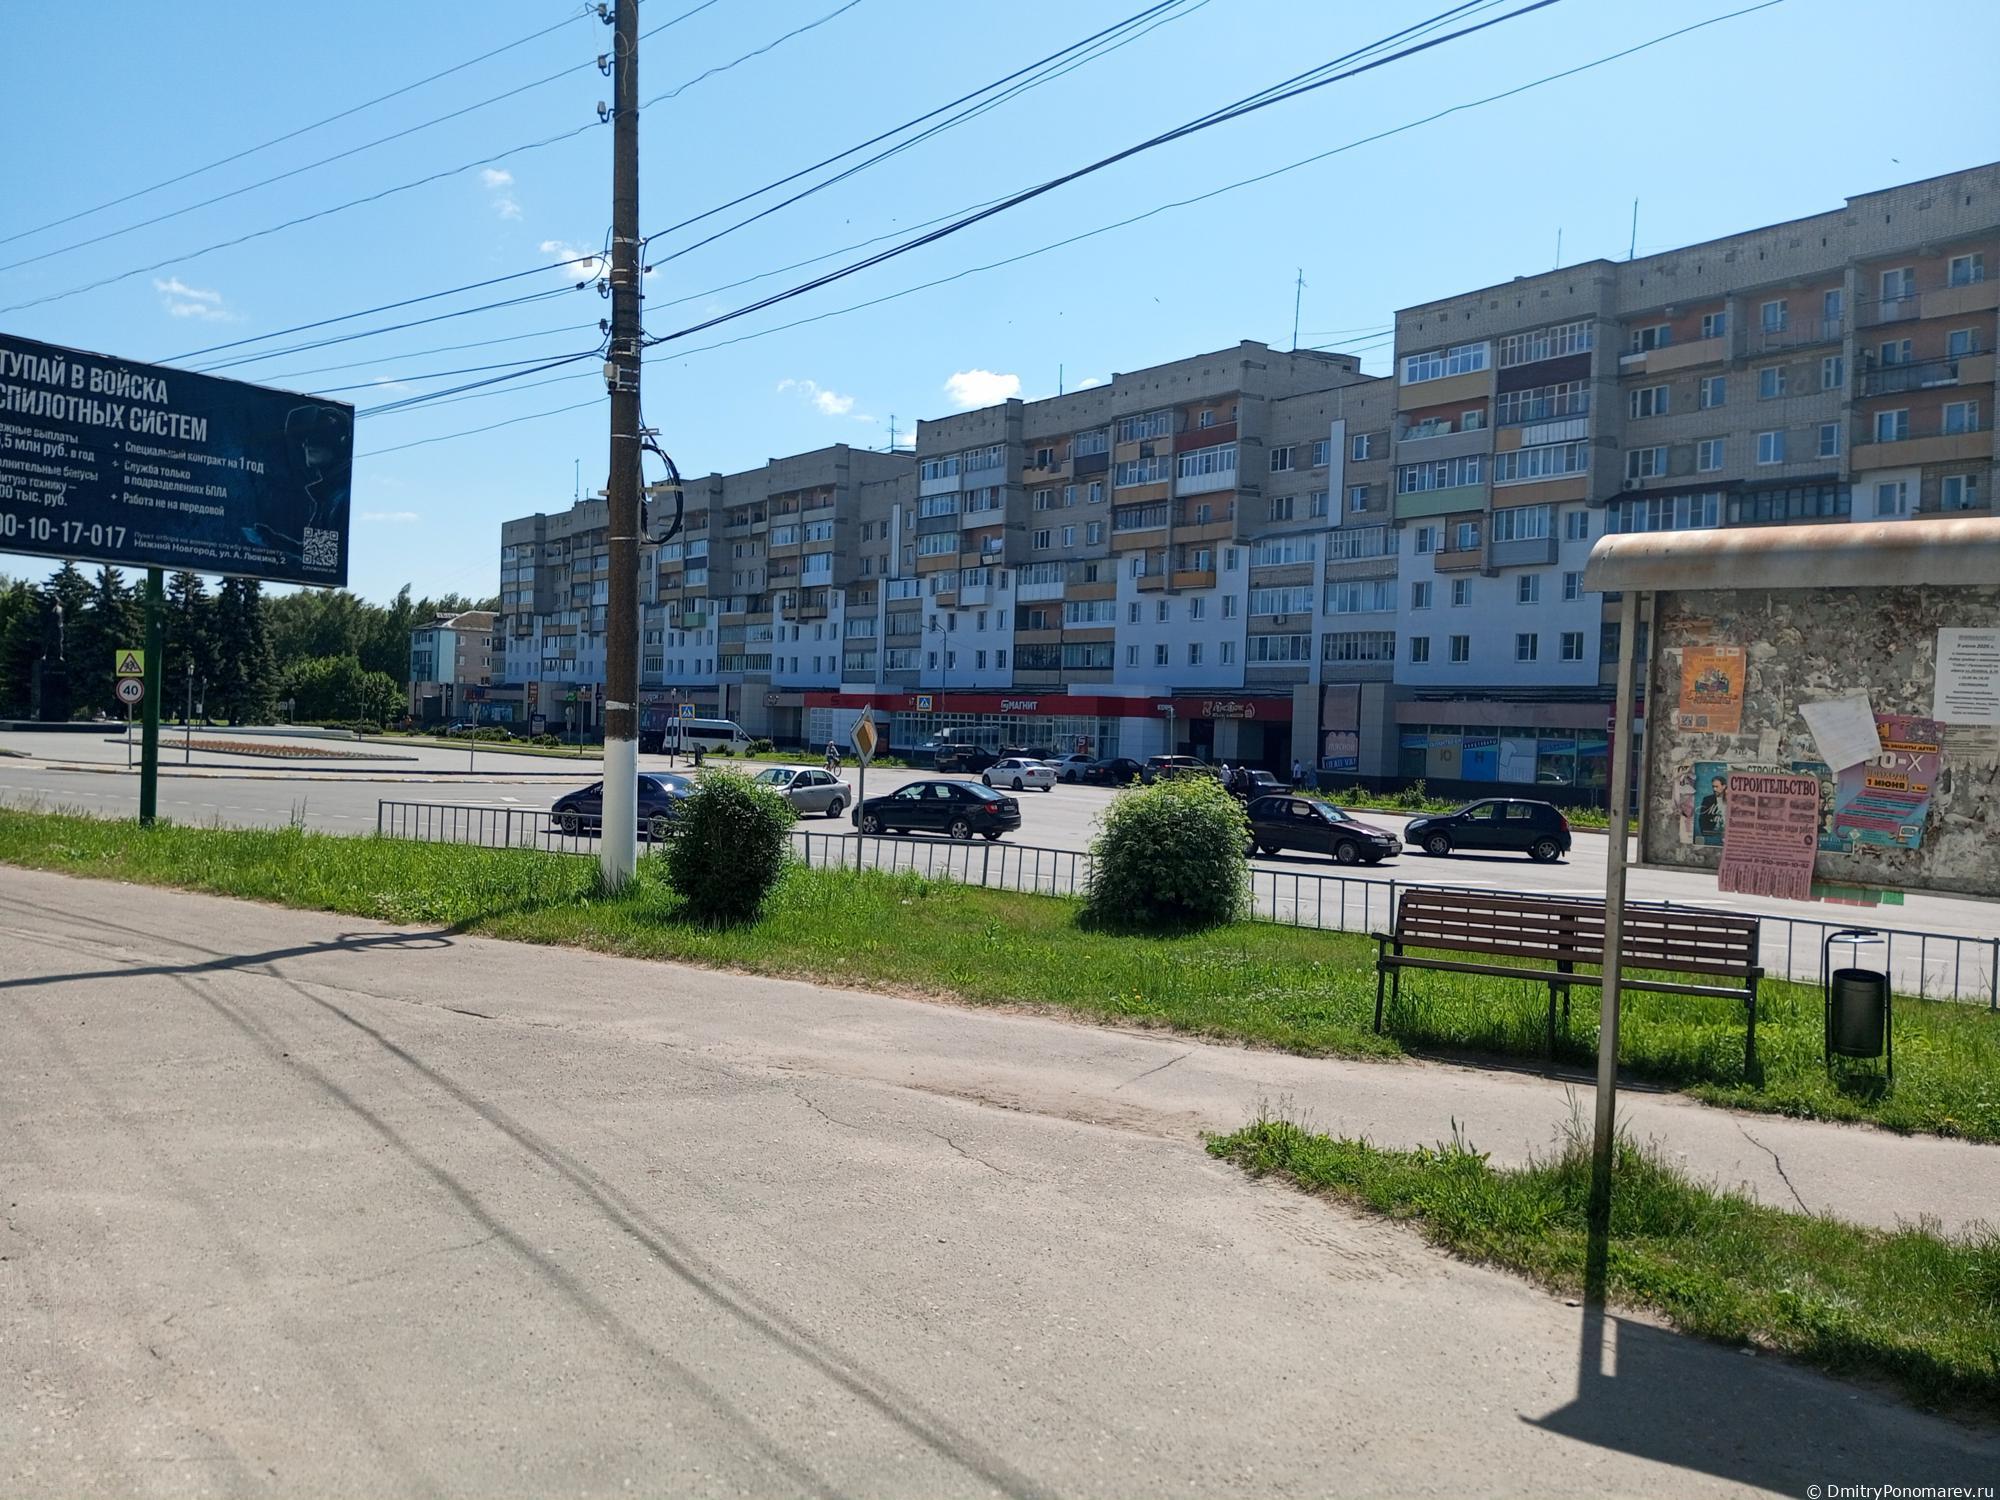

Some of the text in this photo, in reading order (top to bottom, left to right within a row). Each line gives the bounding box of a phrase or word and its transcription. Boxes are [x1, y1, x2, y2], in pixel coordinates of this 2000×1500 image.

[71, 363, 85, 389] В
[90, 367, 168, 405] ВОЙСКА
[129, 407, 207, 442] СИСТЕМ
[33, 428, 79, 444] выплаты
[15, 438, 41, 453] млн
[43, 443, 68, 458] руб.
[70, 449, 77, 458] в
[78, 450, 95, 462] год
[125, 441, 264, 475] Специальный контракт на 1 год
[63, 466, 99, 482] бонусы
[124, 460, 191, 480] Служба только
[29, 478, 67, 494] технику
[124, 475, 228, 498] в подразделениях БПЛА
[15, 489, 42, 503] тыс.
[44, 493, 68, 507] руб.
[123, 492, 225, 517] Работа не на передовой
[134, 539, 171, 551] Нижний
[172, 543, 218, 557] Новгород,
[219, 550, 232, 559] ул.
[233, 551, 242, 559] А.
[280, 556, 287, 564] 2
[123, 685, 138, 696] 40
[1009, 700, 1039, 711] МАГНИТ
[1890, 743, 1917, 751] ЗАЩИТЫ
[1730, 776, 1816, 796] СТРОИТЕЛЬСТВО
[1867, 778, 1873, 786] 1
[1874, 779, 1906, 790] ИЮНЯ
